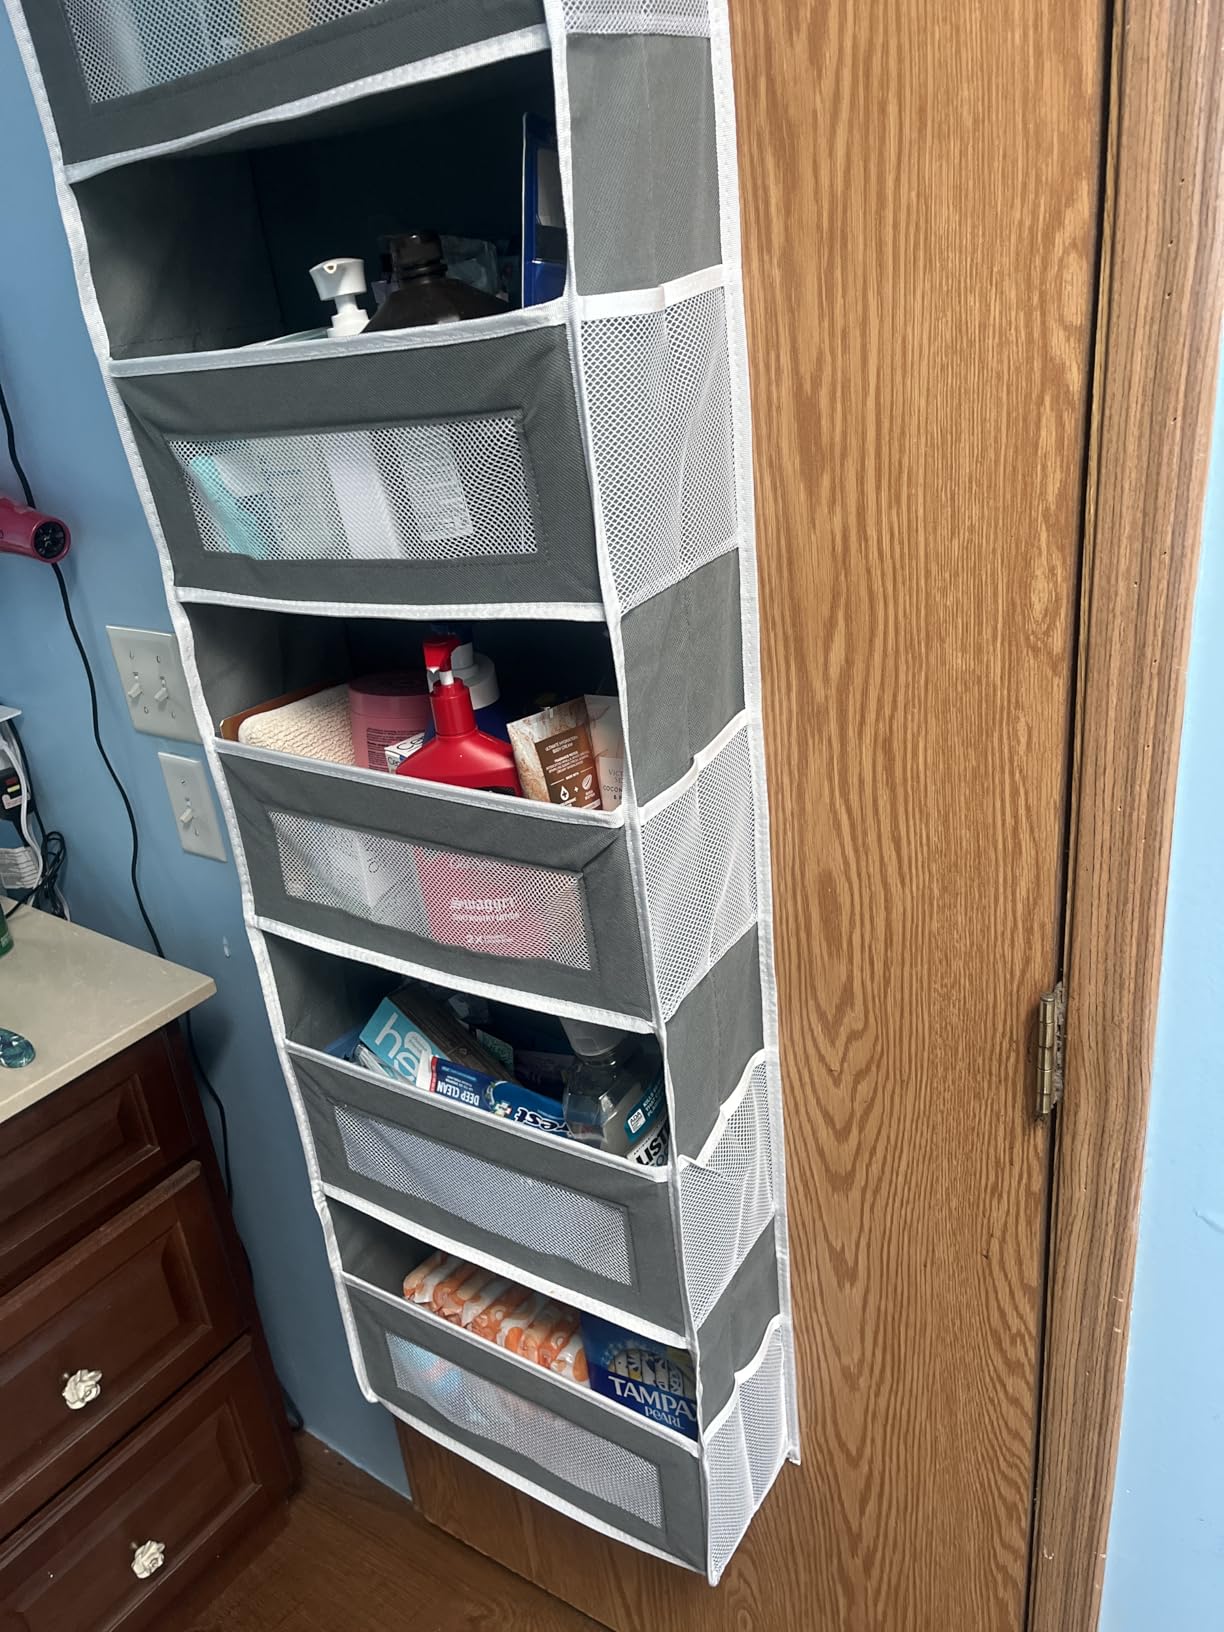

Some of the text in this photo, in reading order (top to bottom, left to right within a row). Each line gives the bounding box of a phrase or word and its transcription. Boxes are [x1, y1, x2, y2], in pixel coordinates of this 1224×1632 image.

[437, 1080, 460, 1098] CLEAN
[461, 1090, 480, 1106] DEEP
[514, 1107, 572, 1134] rest
